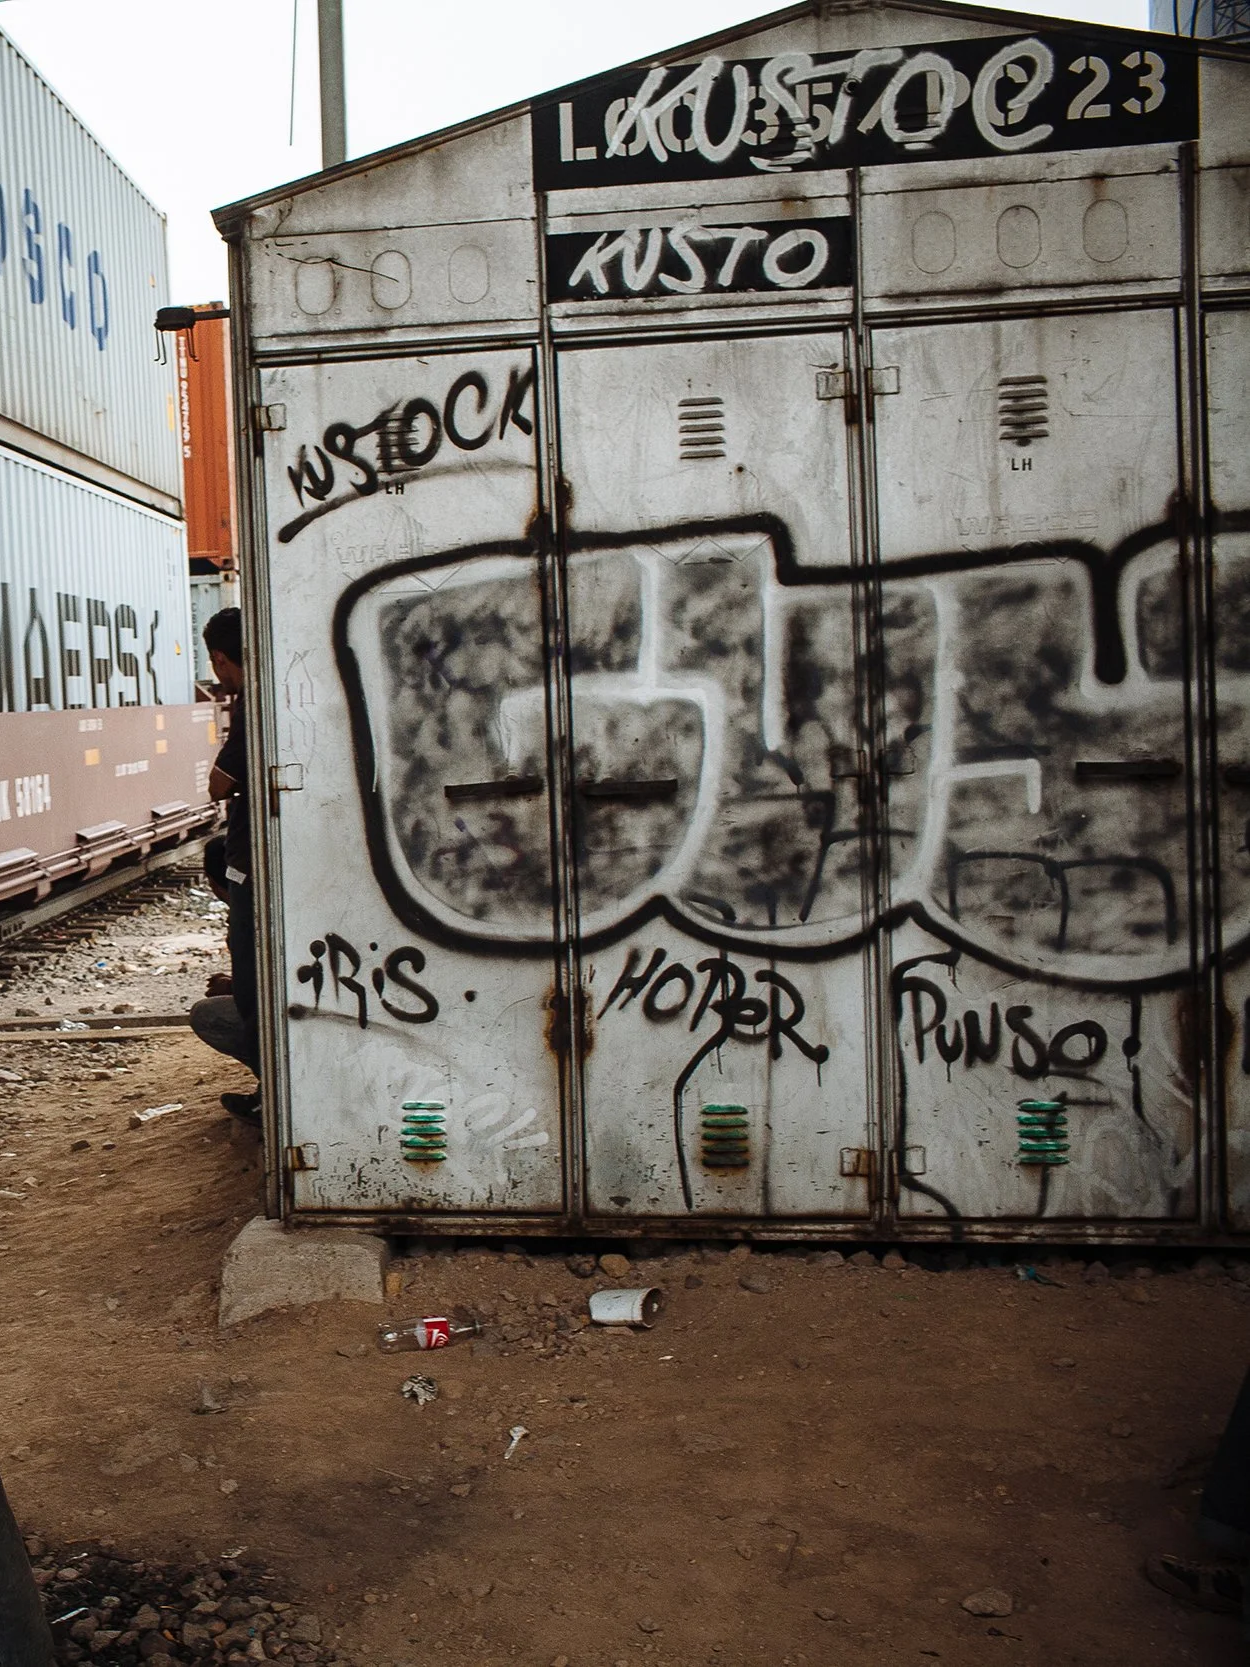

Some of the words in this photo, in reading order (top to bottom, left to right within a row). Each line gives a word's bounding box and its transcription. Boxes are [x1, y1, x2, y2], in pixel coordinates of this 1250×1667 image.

[1066, 51, 1166, 119] 23
[567, 224, 827, 294] KUSTO
[1011, 458, 1032, 471] LH
[385, 482, 405, 495] LH
